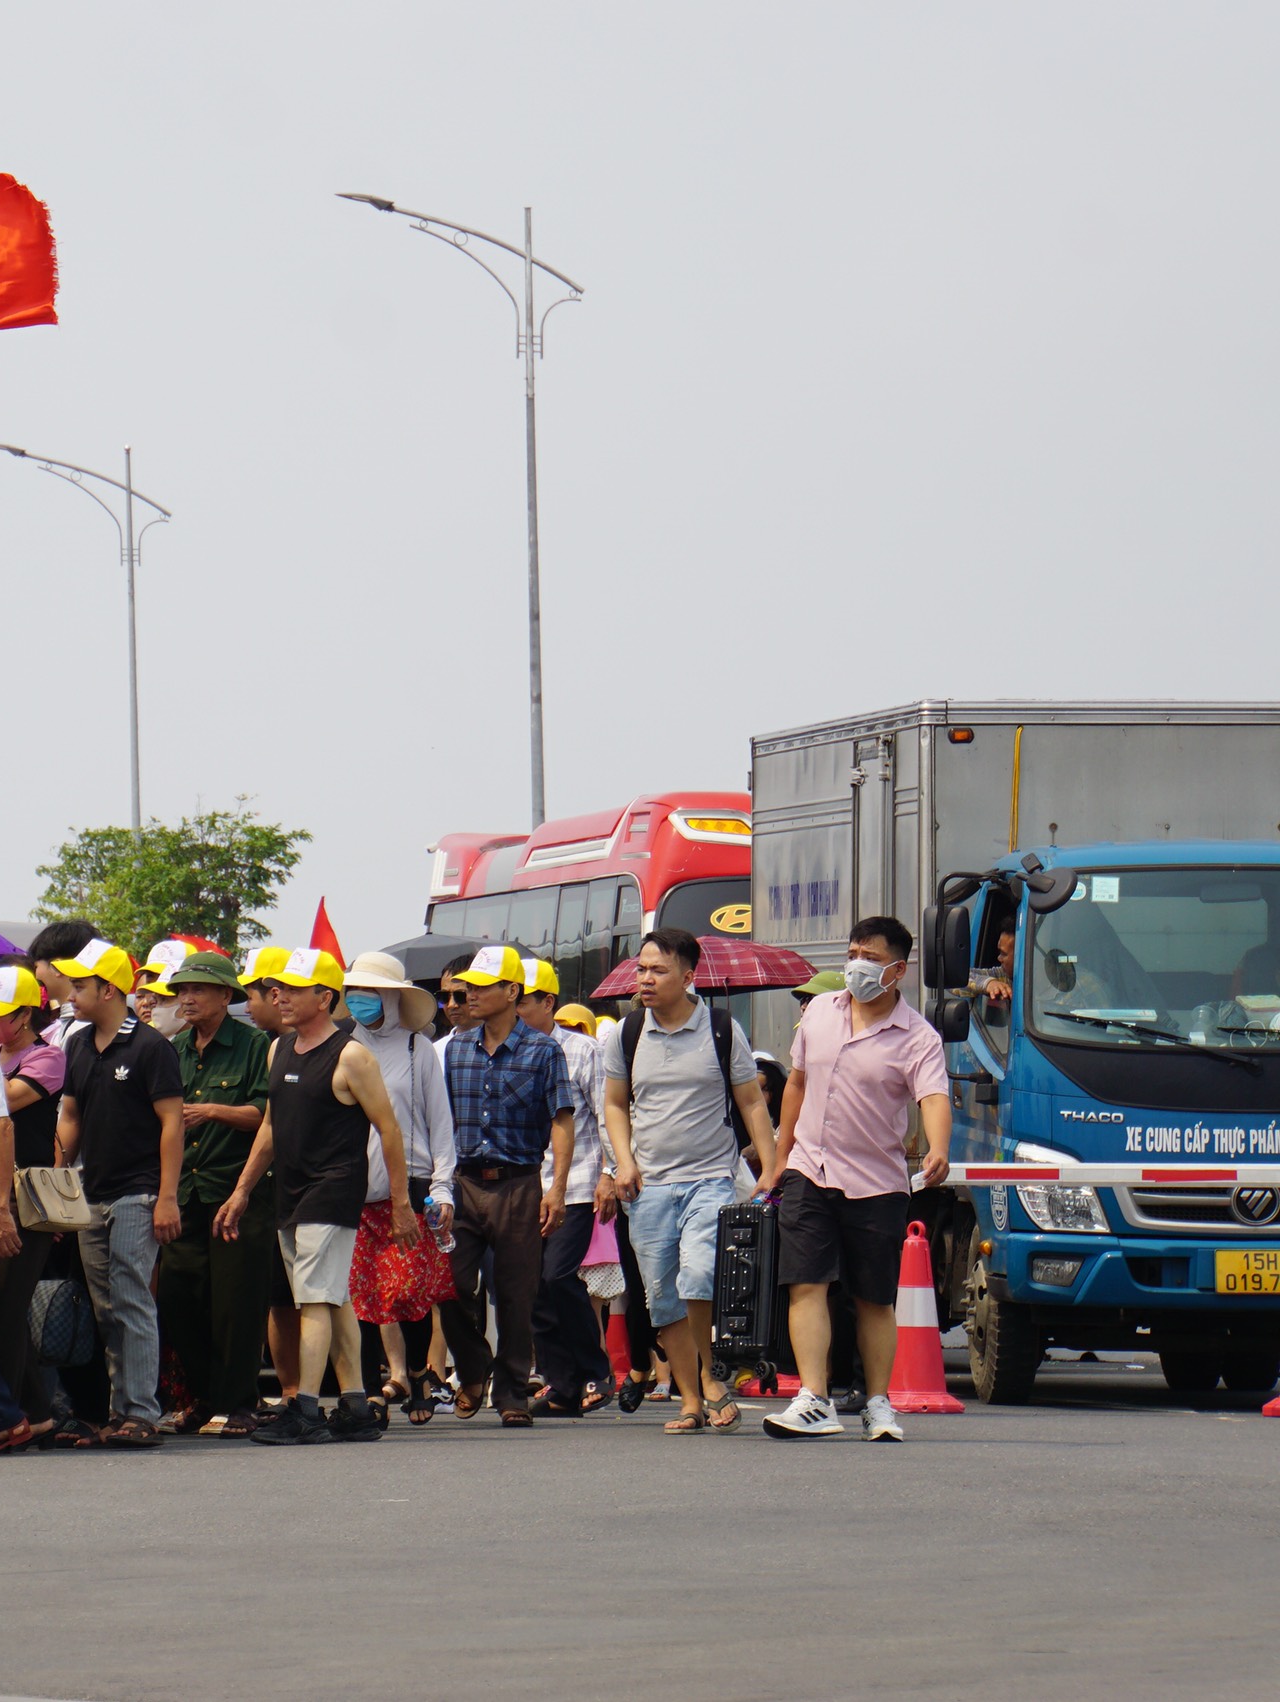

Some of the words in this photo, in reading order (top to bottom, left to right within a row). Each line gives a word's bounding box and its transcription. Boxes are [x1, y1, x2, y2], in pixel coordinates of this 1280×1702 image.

[1060, 1111, 1124, 1123] THACO
[1125, 1127, 1142, 1151] XE
[1145, 1127, 1181, 1152] CUNG
[1184, 1121, 1210, 1153] CẤP
[1213, 1127, 1245, 1158] THỰC
[1243, 1253, 1278, 1270] 15H
